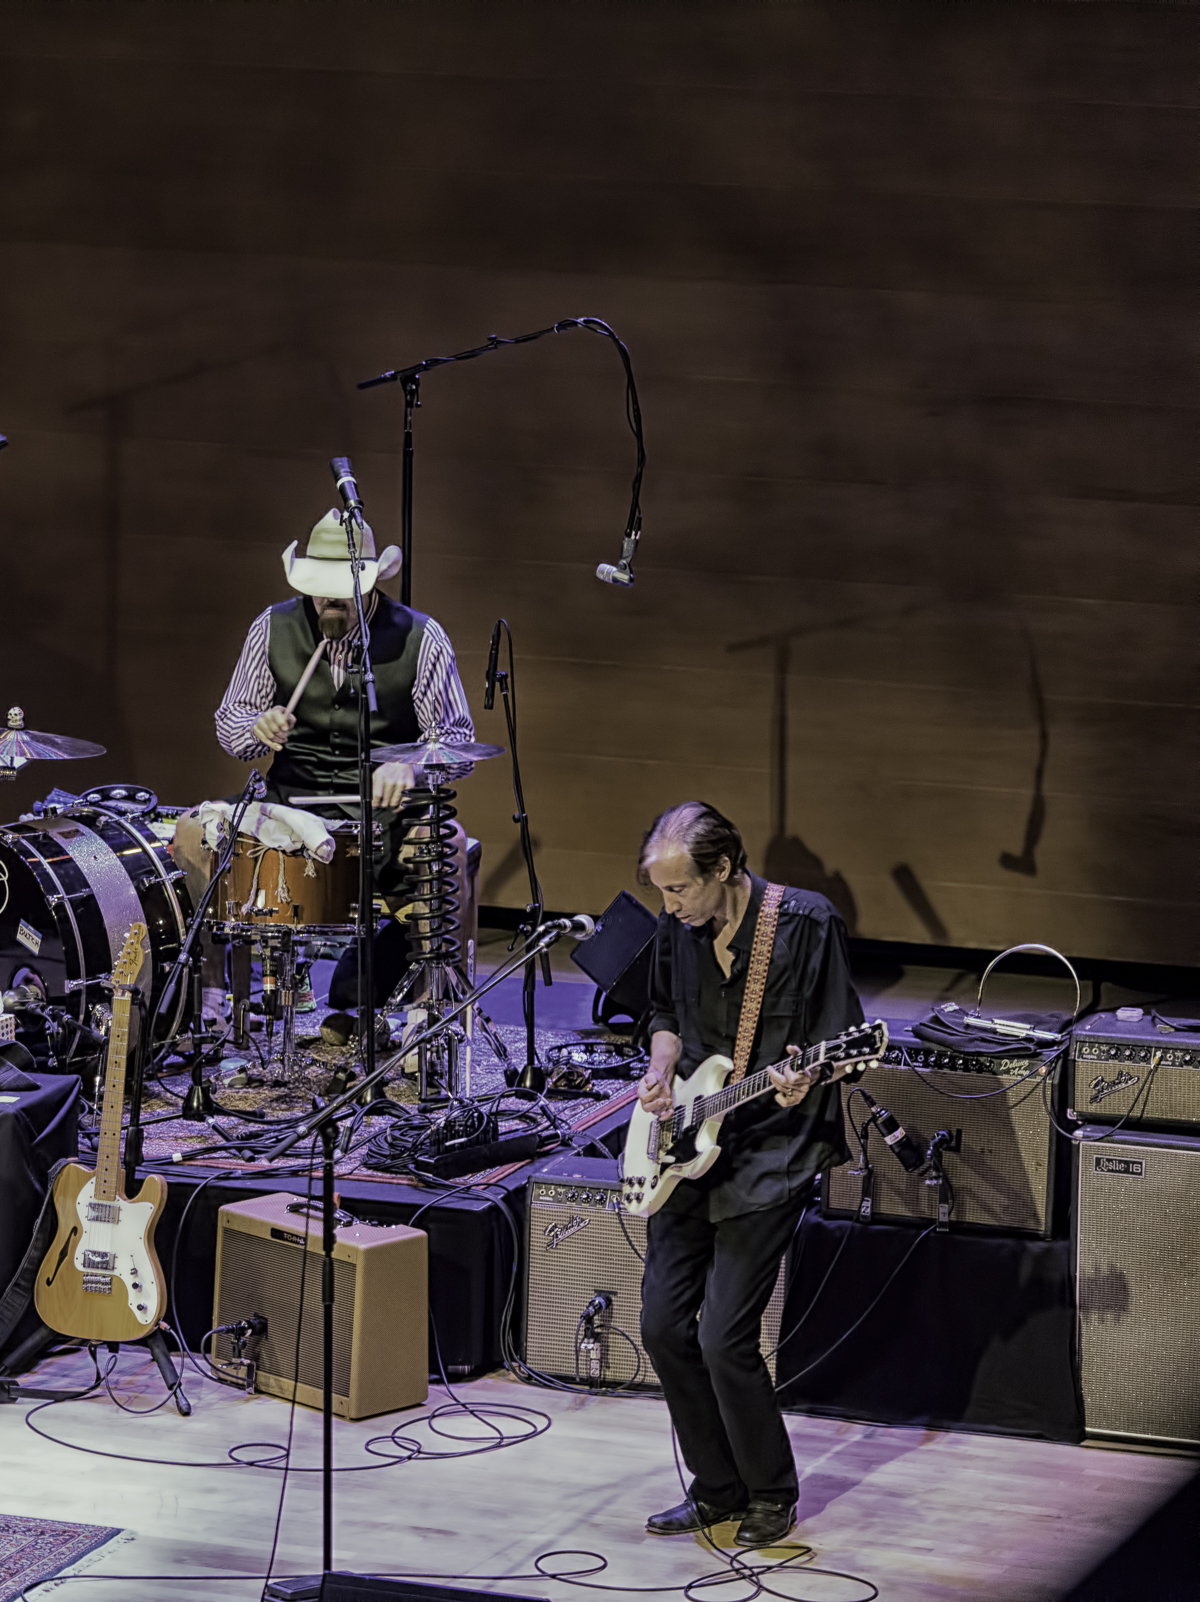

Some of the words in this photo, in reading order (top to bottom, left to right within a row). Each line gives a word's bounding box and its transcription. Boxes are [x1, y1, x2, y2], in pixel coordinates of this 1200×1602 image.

[18, 925, 40, 948] BUTCH
[999, 1058, 1030, 1071] Deluxe
[1009, 1067, 1030, 1076] Amp
[1089, 1070, 1139, 1103] Fender
[1096, 1158, 1125, 1172] Leslie
[1129, 1163, 1142, 1173] 16
[544, 1215, 591, 1251] Fender
